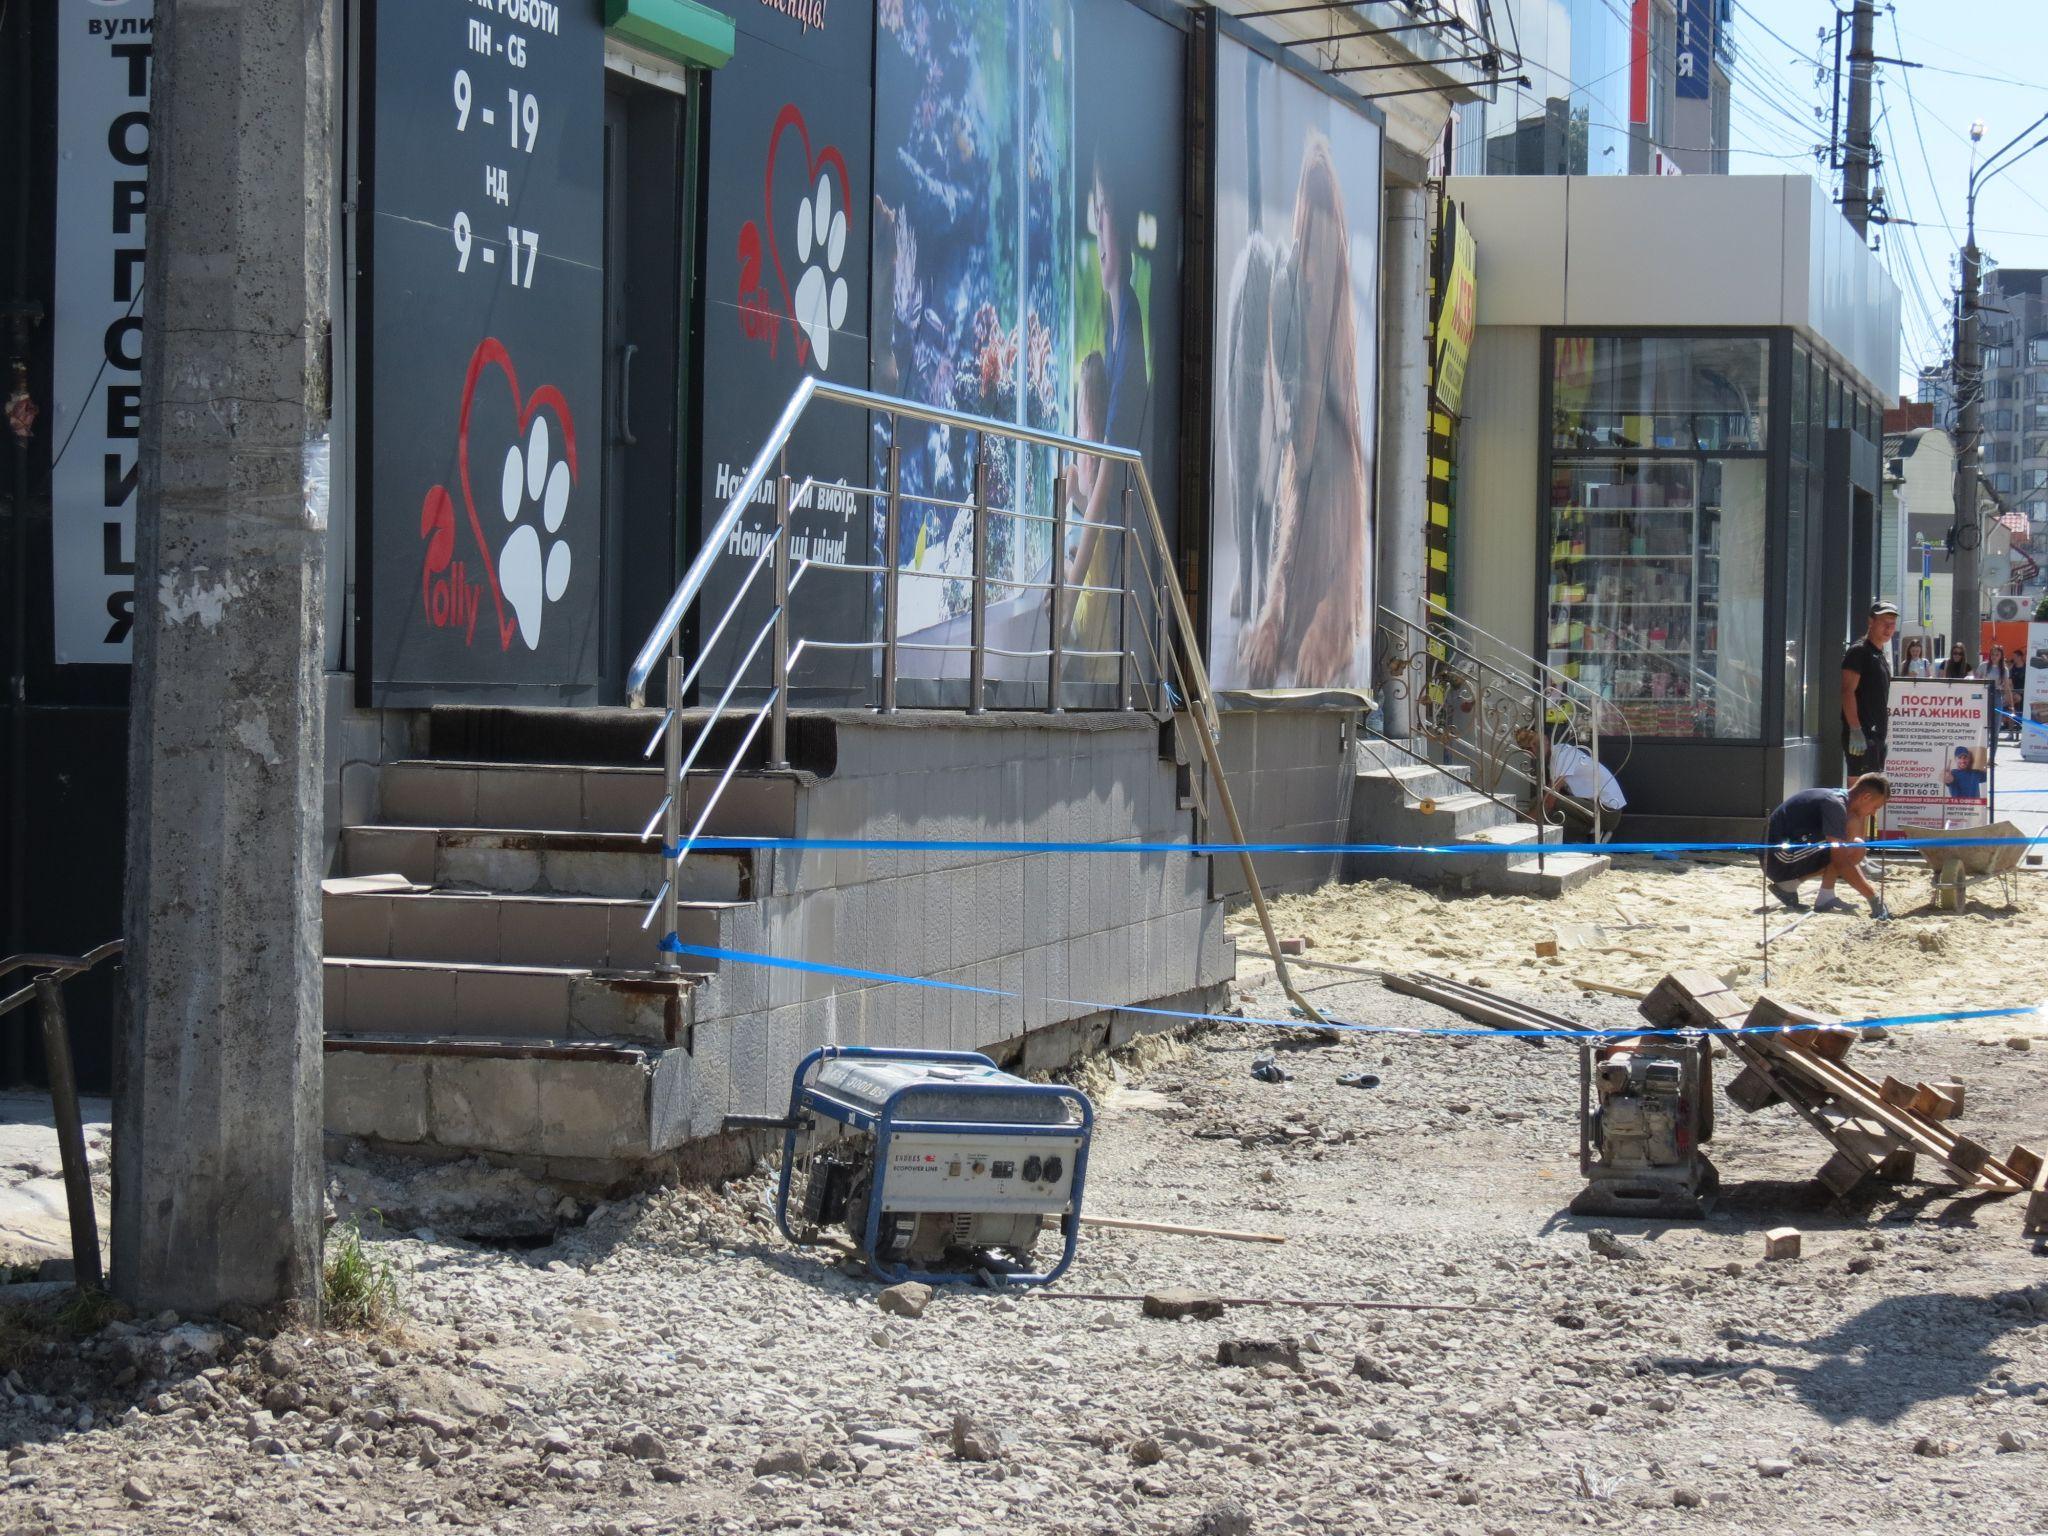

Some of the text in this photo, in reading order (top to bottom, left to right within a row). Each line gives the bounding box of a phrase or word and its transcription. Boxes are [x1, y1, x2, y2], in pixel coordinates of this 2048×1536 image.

[88, 18, 154, 40] вули
[469, 18, 492, 56] ПН
[507, 34, 527, 68] СБ
[453, 69, 472, 132] 9
[508, 87, 539, 153] 19
[486, 164, 509, 207] НД
[453, 211, 472, 273] 9
[507, 225, 539, 289] 17
[817, 477, 858, 523] вибір.
[421, 484, 482, 647] Polly
[813, 528, 848, 564] ціни!
[1901, 695, 1963, 706] ПОСЛУГИ
